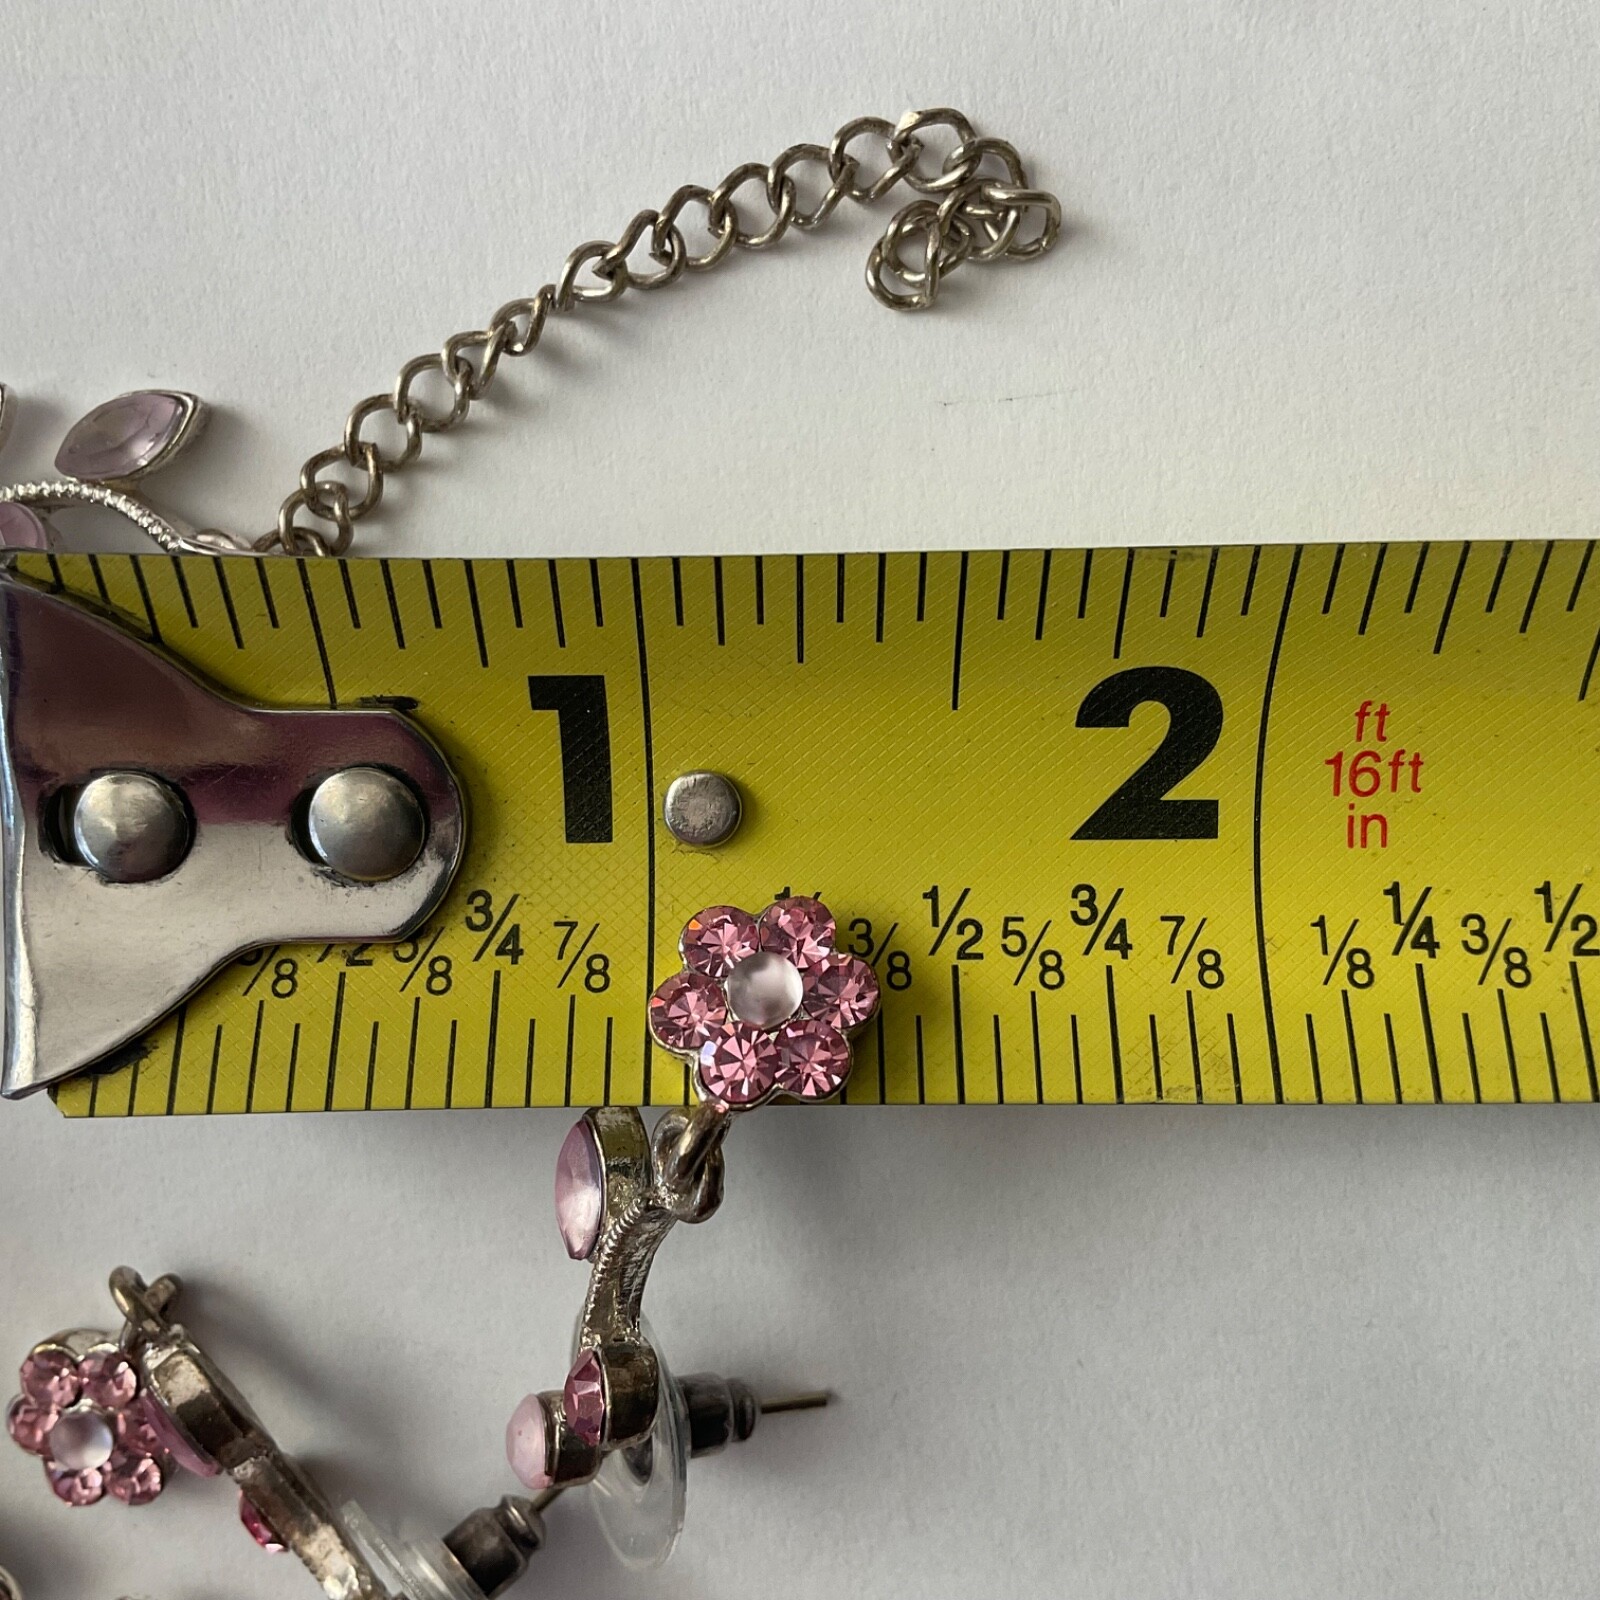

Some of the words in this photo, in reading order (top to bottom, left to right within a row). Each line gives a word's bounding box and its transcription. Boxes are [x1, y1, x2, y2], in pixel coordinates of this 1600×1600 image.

[528, 674, 613, 844] 1
[1069, 665, 1224, 841] 2
[1354, 700, 1391, 743] ft
[1324, 748, 1424, 798] 16ft
[1346, 802, 1388, 849] in
[464, 889, 524, 966] 3/4
[553, 920, 610, 993] 7/8
[848, 917, 912, 991] 3/8
[922, 884, 985, 961] 1/2
[1000, 915, 1066, 991] 5/8
[1069, 882, 1133, 961] 3/4
[1159, 914, 1226, 990] 7/8
[1310, 914, 1376, 990] 1/8
[1382, 880, 1441, 960] 1/4
[1460, 912, 1533, 989] 3/8
[1533, 880, 1600, 958] 1/2
